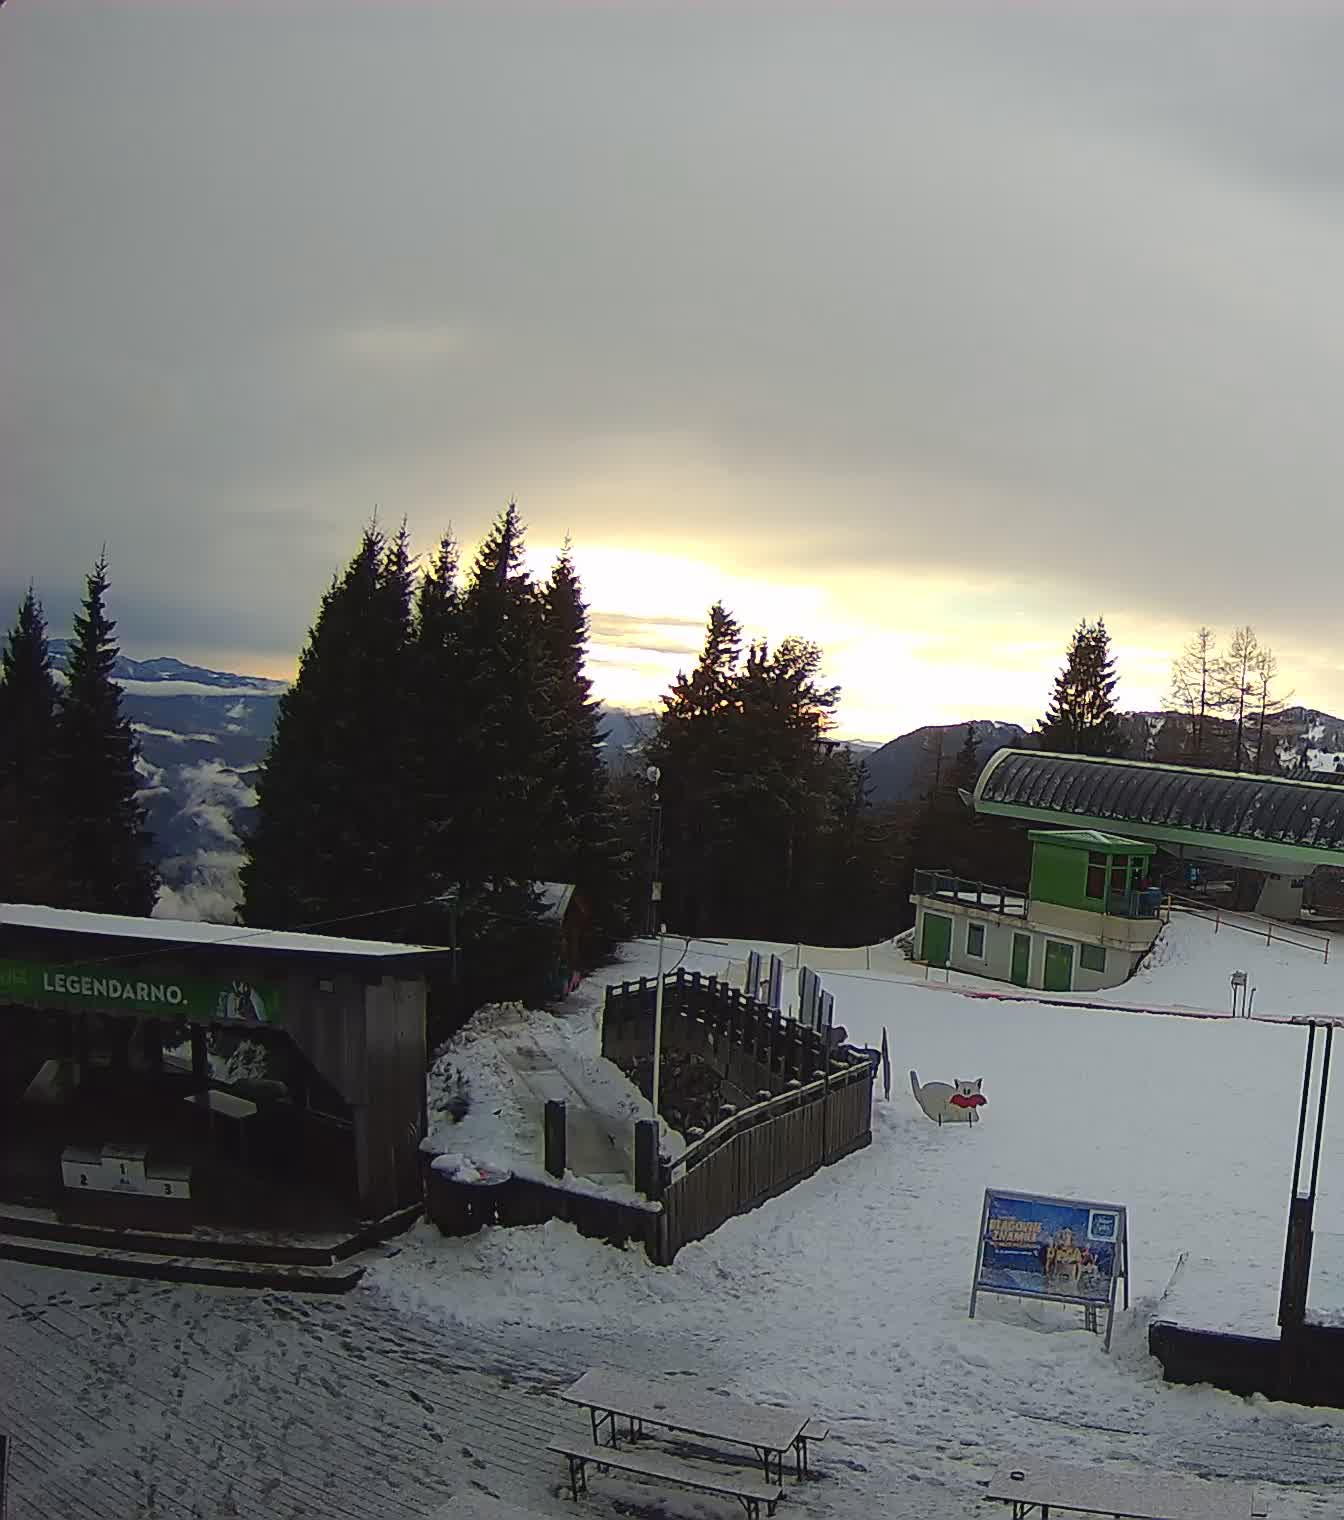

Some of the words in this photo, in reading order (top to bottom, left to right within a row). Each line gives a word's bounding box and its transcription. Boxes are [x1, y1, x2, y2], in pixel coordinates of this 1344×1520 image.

[43, 972, 189, 1006] LEGENDARNO.
[119, 1163, 127, 1175] 1
[80, 1174, 89, 1186] 2
[164, 1183, 172, 1195] 3
